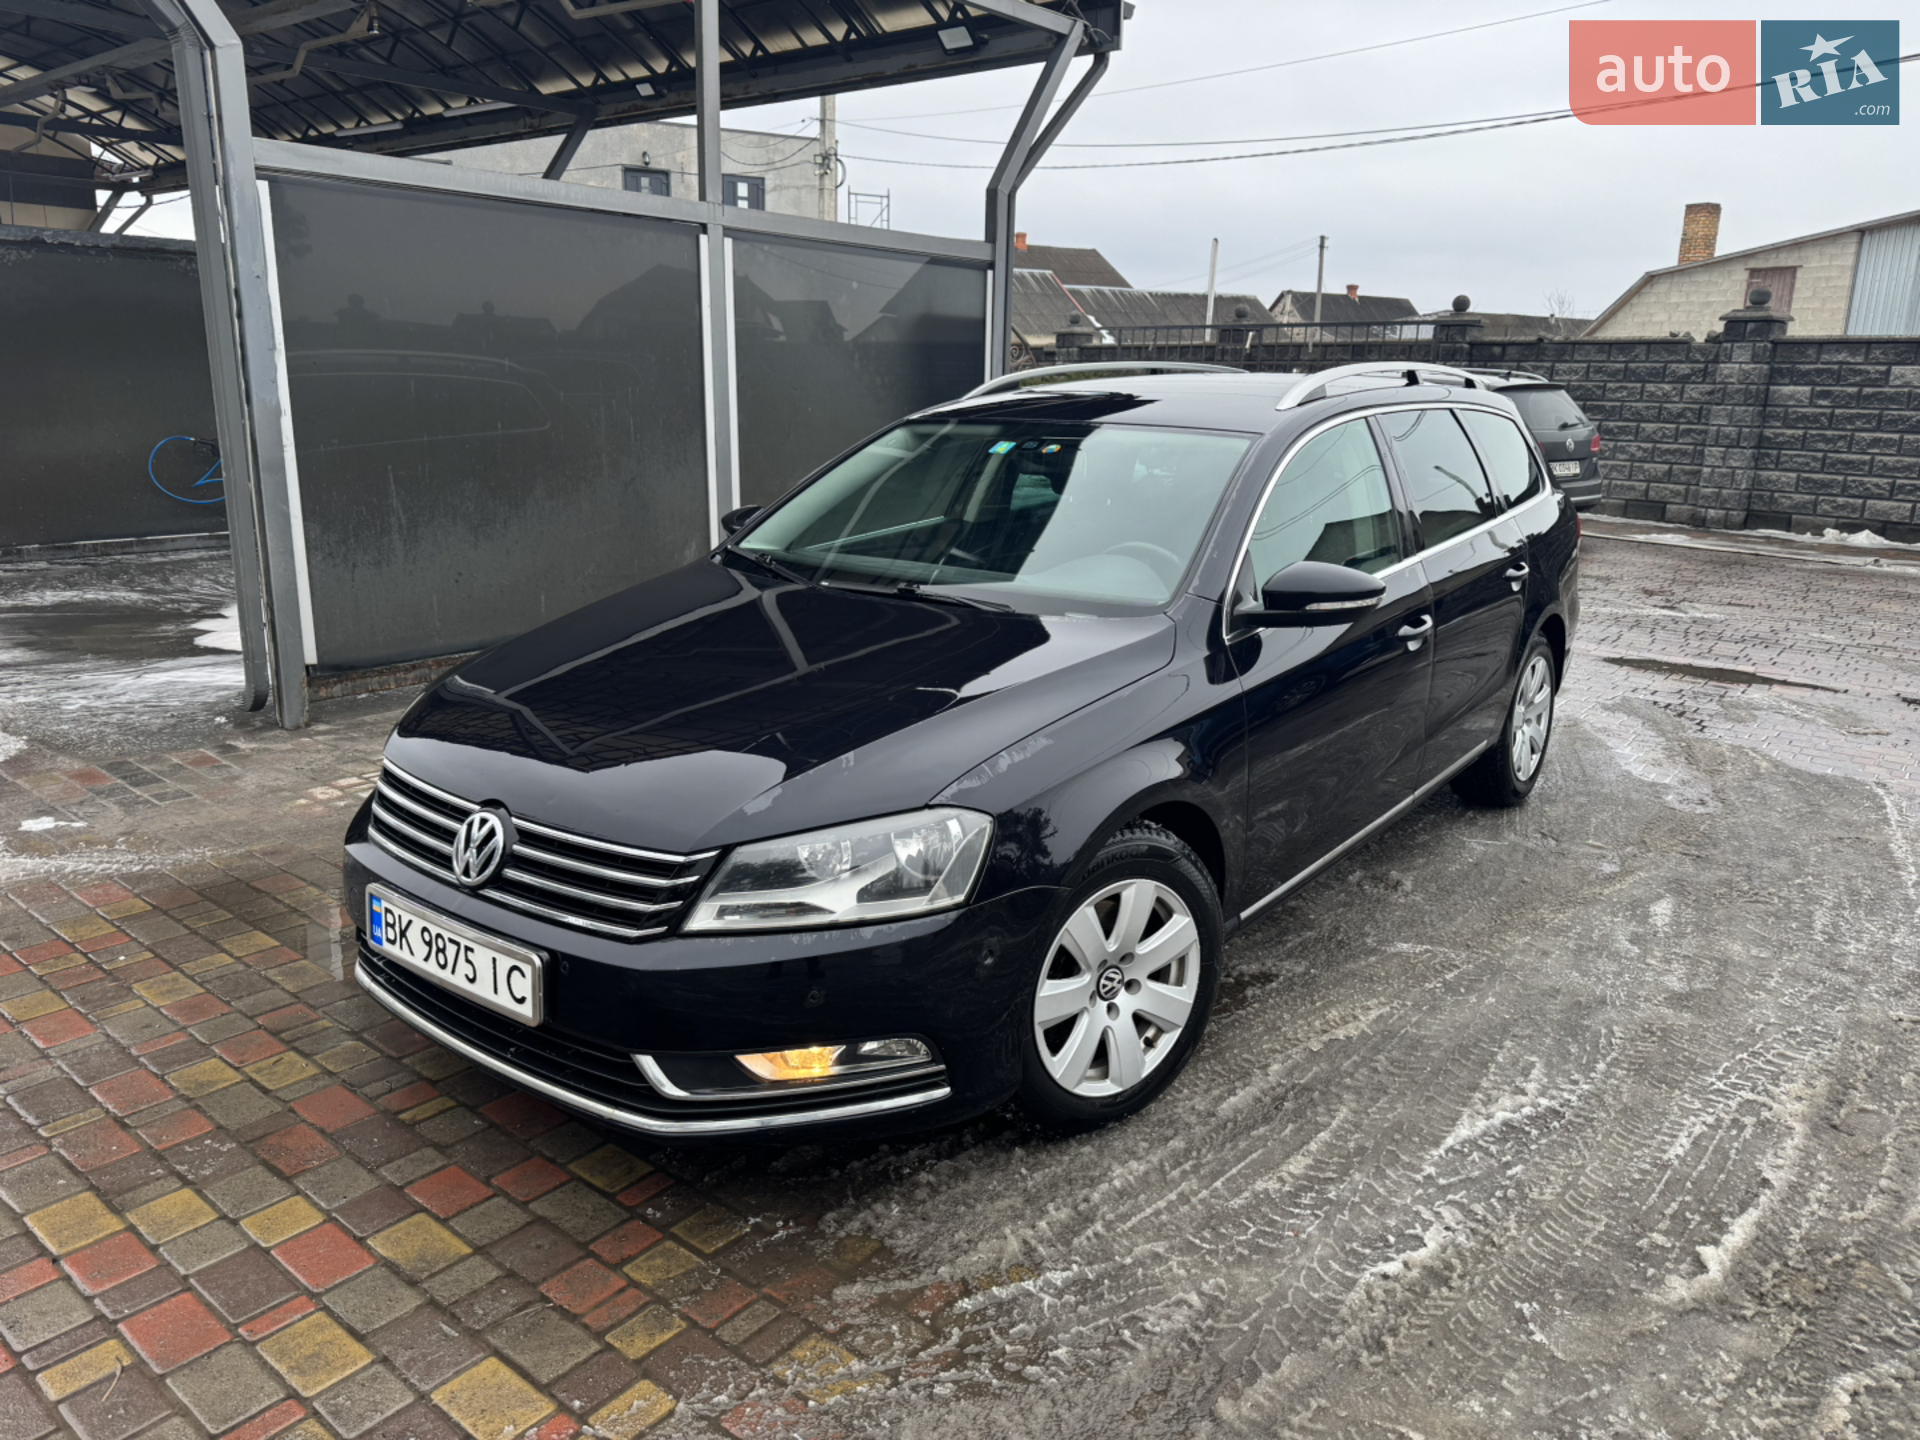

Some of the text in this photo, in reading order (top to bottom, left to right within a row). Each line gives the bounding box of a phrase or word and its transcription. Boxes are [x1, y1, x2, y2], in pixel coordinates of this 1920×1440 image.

[384, 906, 528, 1005] BK 9875 IC
